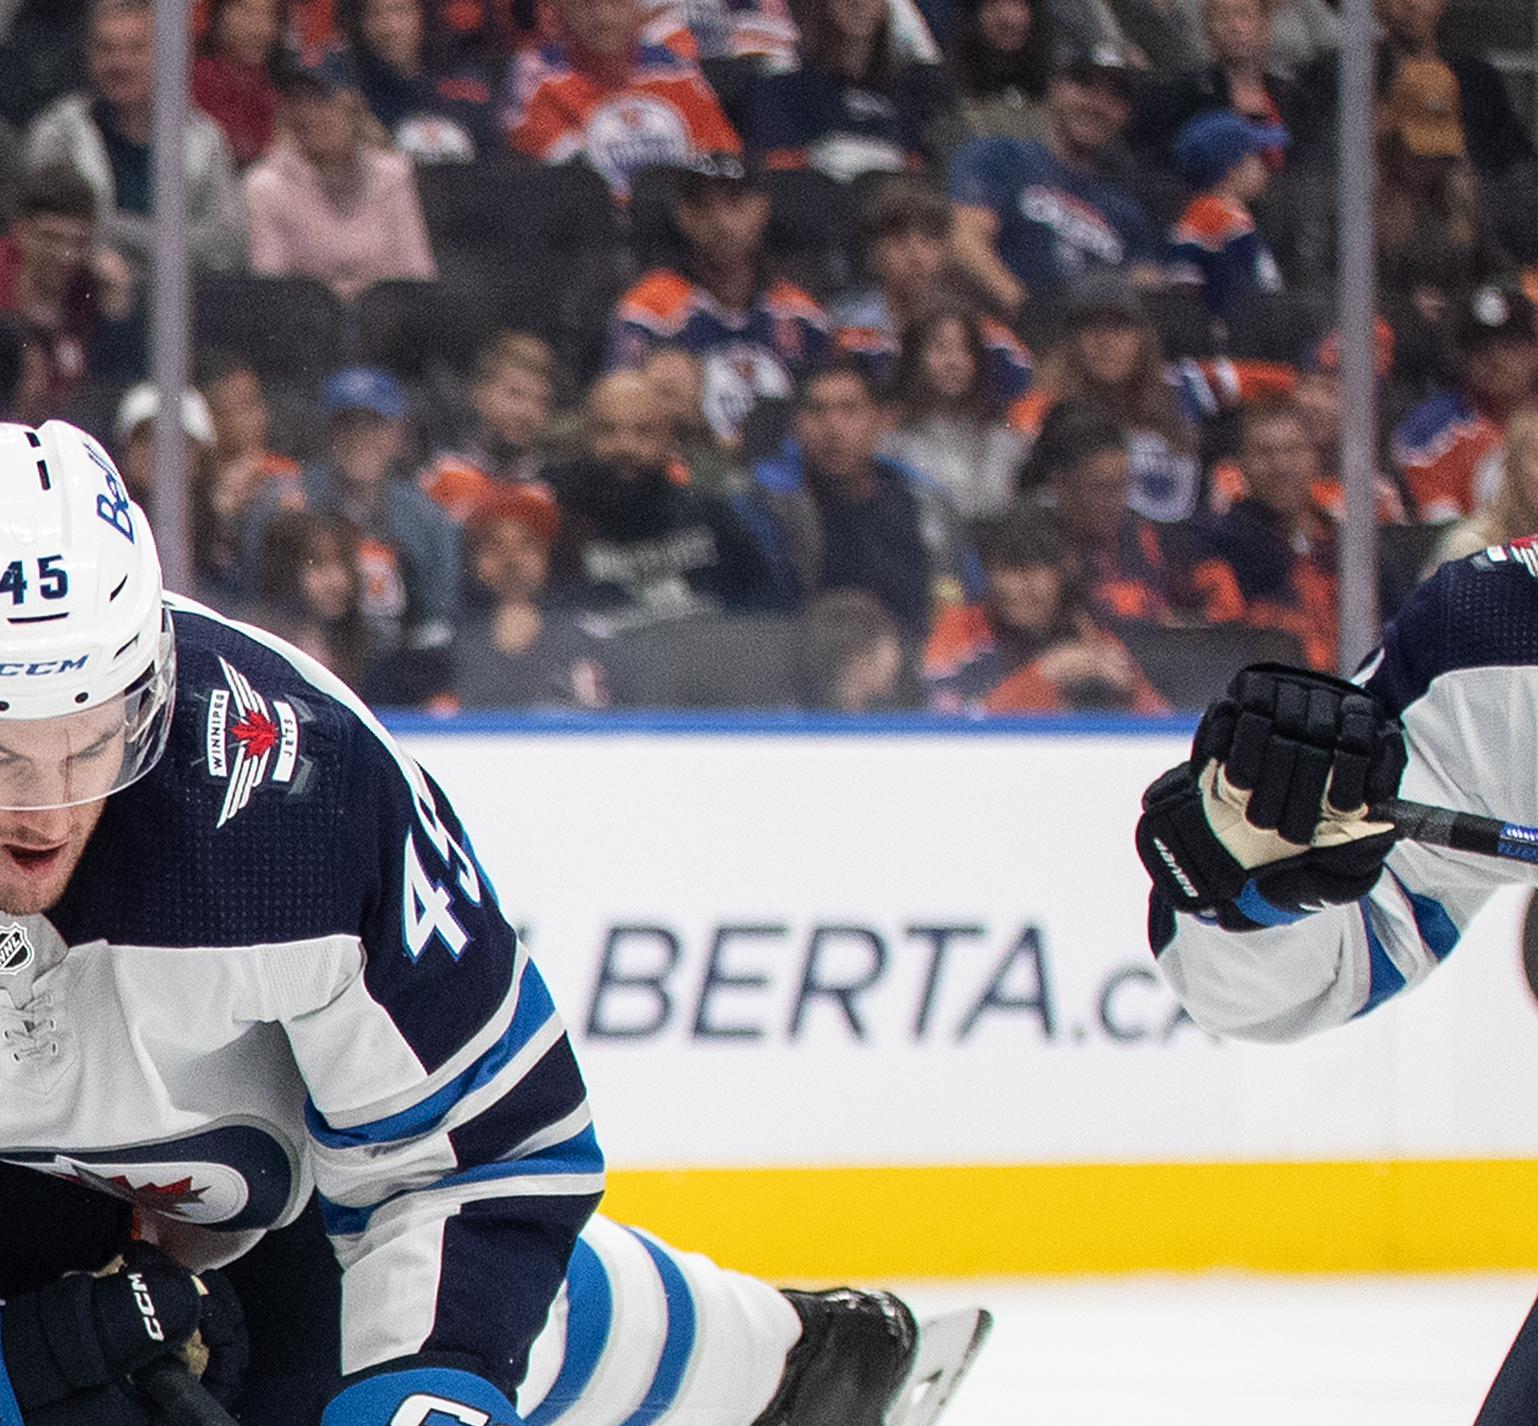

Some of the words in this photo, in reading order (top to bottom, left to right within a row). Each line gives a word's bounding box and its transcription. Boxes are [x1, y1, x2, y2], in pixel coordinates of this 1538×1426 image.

[82, 440, 137, 544] Bell
[210, 692, 226, 770] WINNIPEG
[282, 718, 295, 758] JETS
[402, 768, 482, 958] 45
[127, 1272, 165, 1342] CCM
